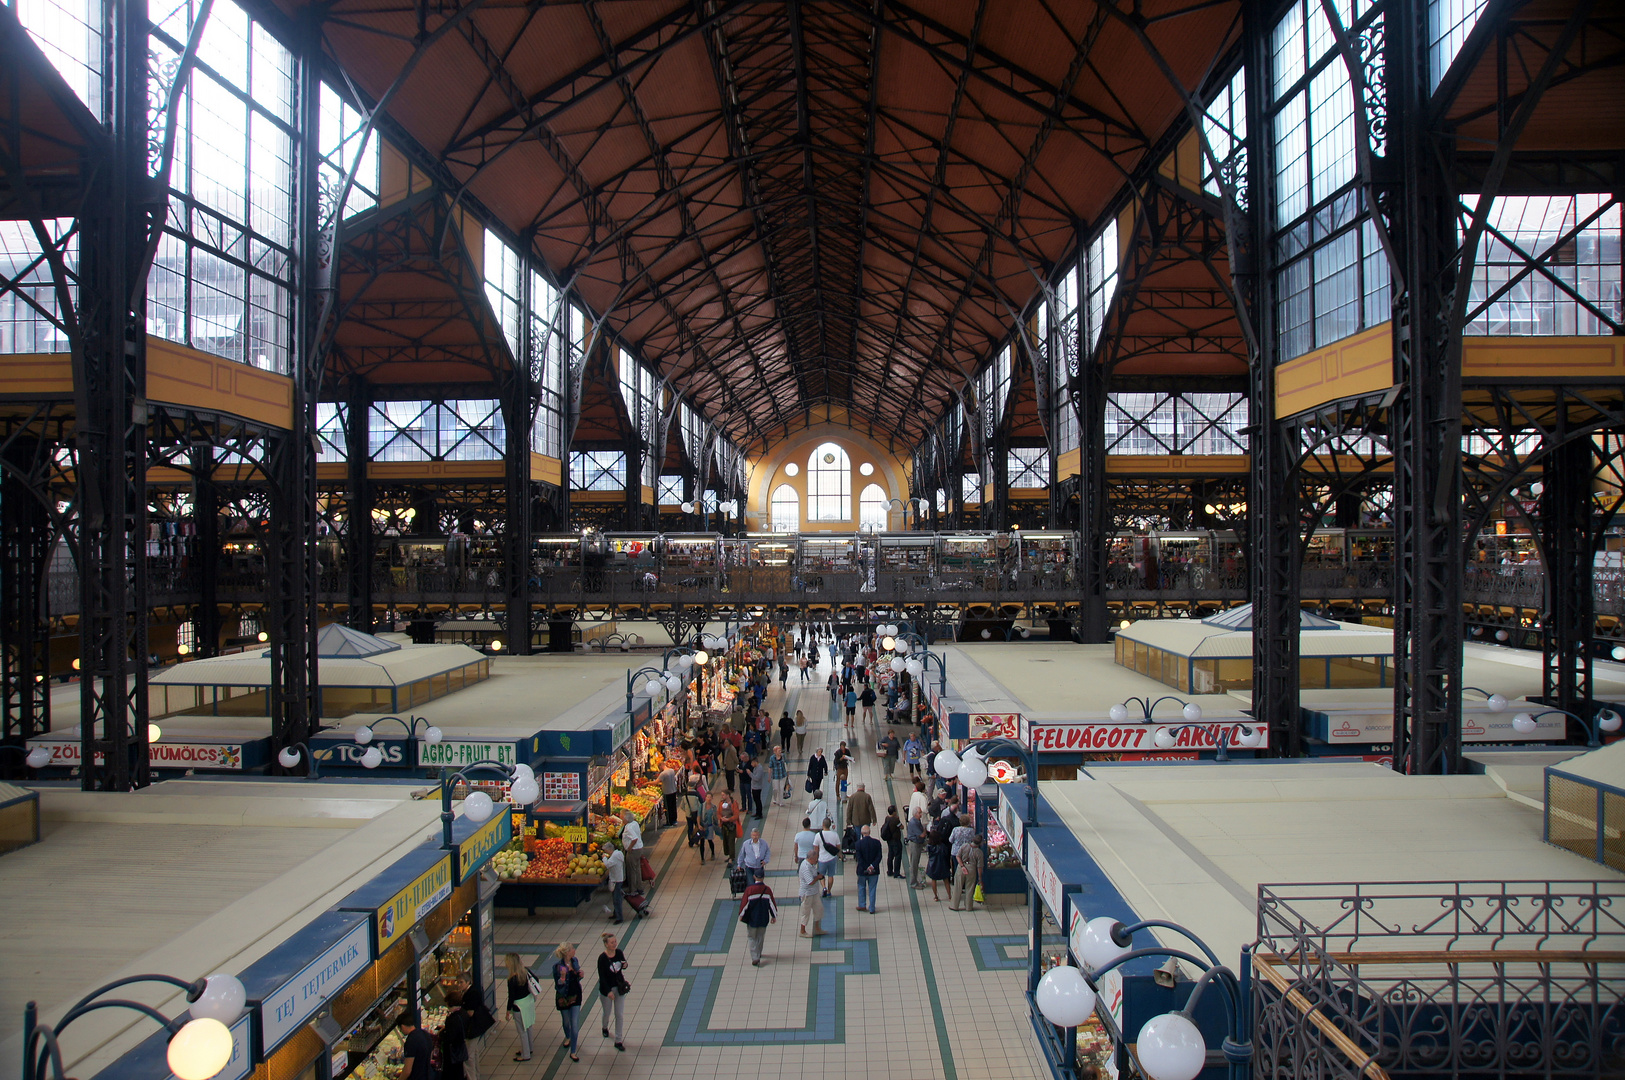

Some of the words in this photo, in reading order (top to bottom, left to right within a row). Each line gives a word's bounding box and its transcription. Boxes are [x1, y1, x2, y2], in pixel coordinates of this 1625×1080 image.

[1032, 725, 1147, 749] FELVÁGOTT
[337, 741, 403, 763] TOÁS
[422, 743, 492, 764] AGRO-FRUIT
[498, 745, 514, 764] BT.
[275, 994, 296, 1023] TEJ
[302, 943, 359, 1000] TEJTERMÉK
